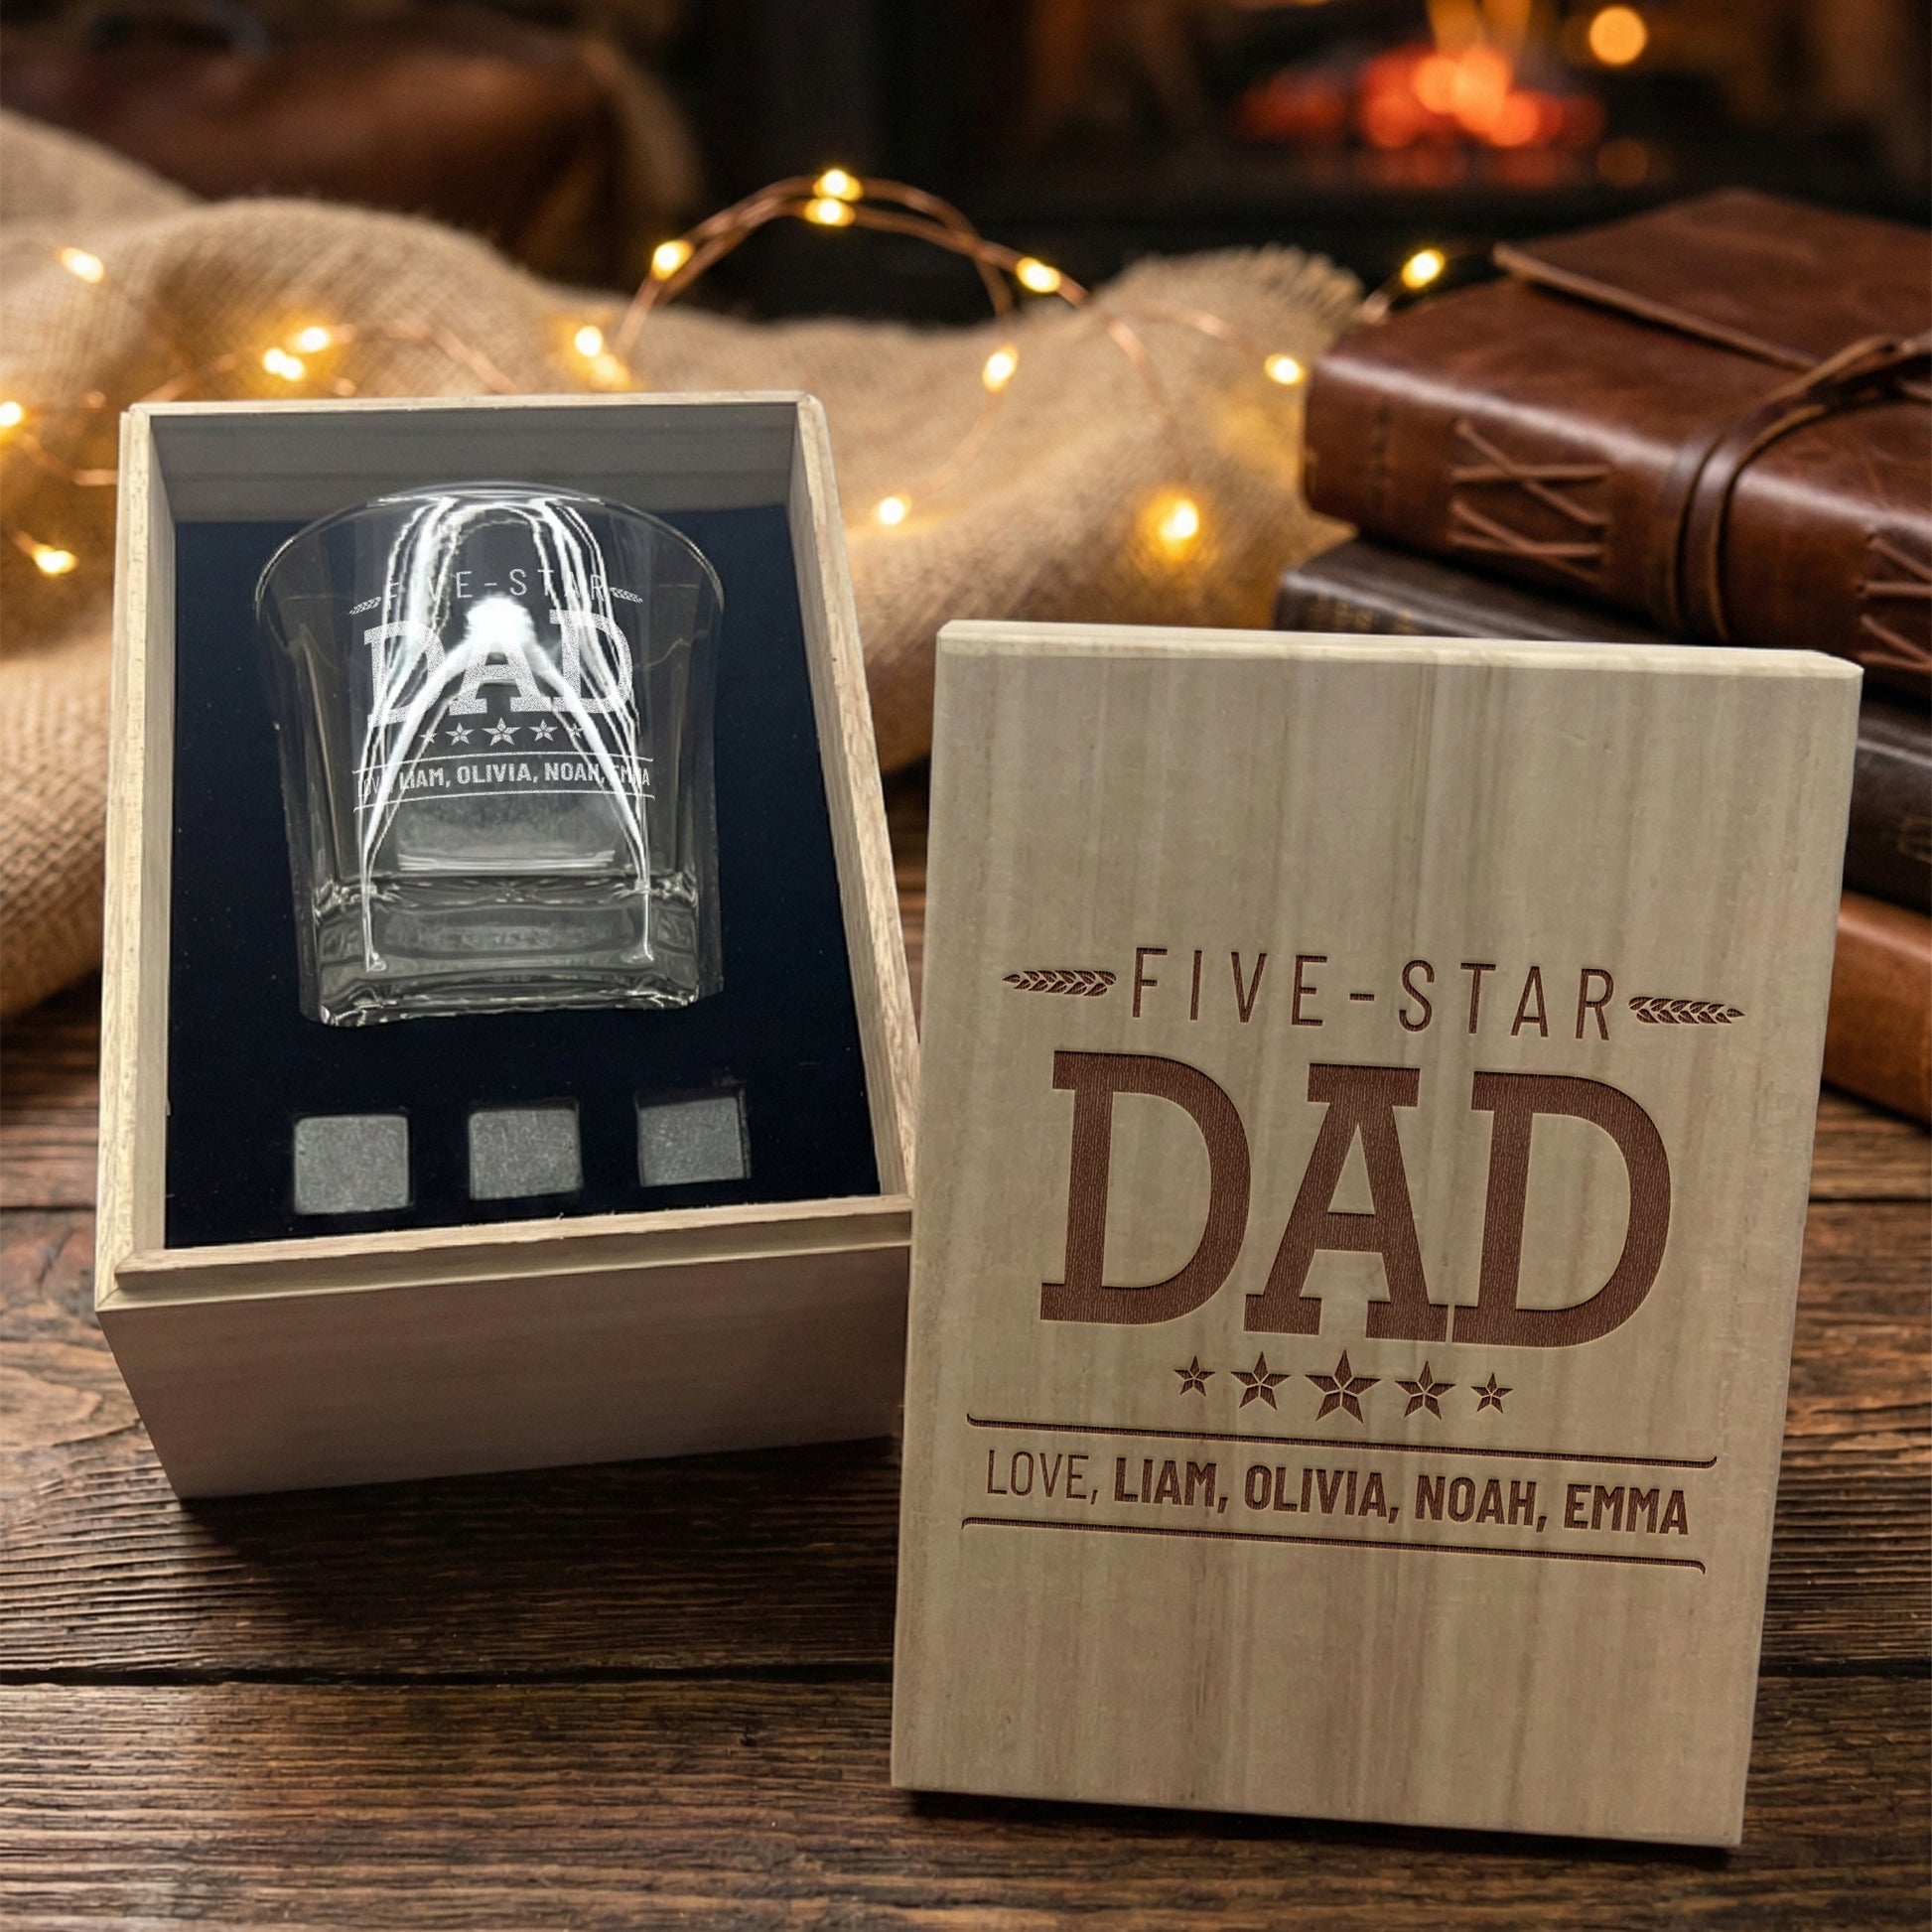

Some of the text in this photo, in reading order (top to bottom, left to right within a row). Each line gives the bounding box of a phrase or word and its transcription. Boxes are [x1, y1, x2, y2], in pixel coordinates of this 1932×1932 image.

[363, 609, 633, 729] DAD
[399, 767, 452, 789] LIAM,
[457, 761, 538, 785] OLIVIA,
[1131, 946, 1616, 1041] FIVE-STAR
[1039, 1049, 1673, 1349] DAD
[987, 1449, 1690, 1536] LOVE, LIAM, OLIVIA, NOAH, EMMA
